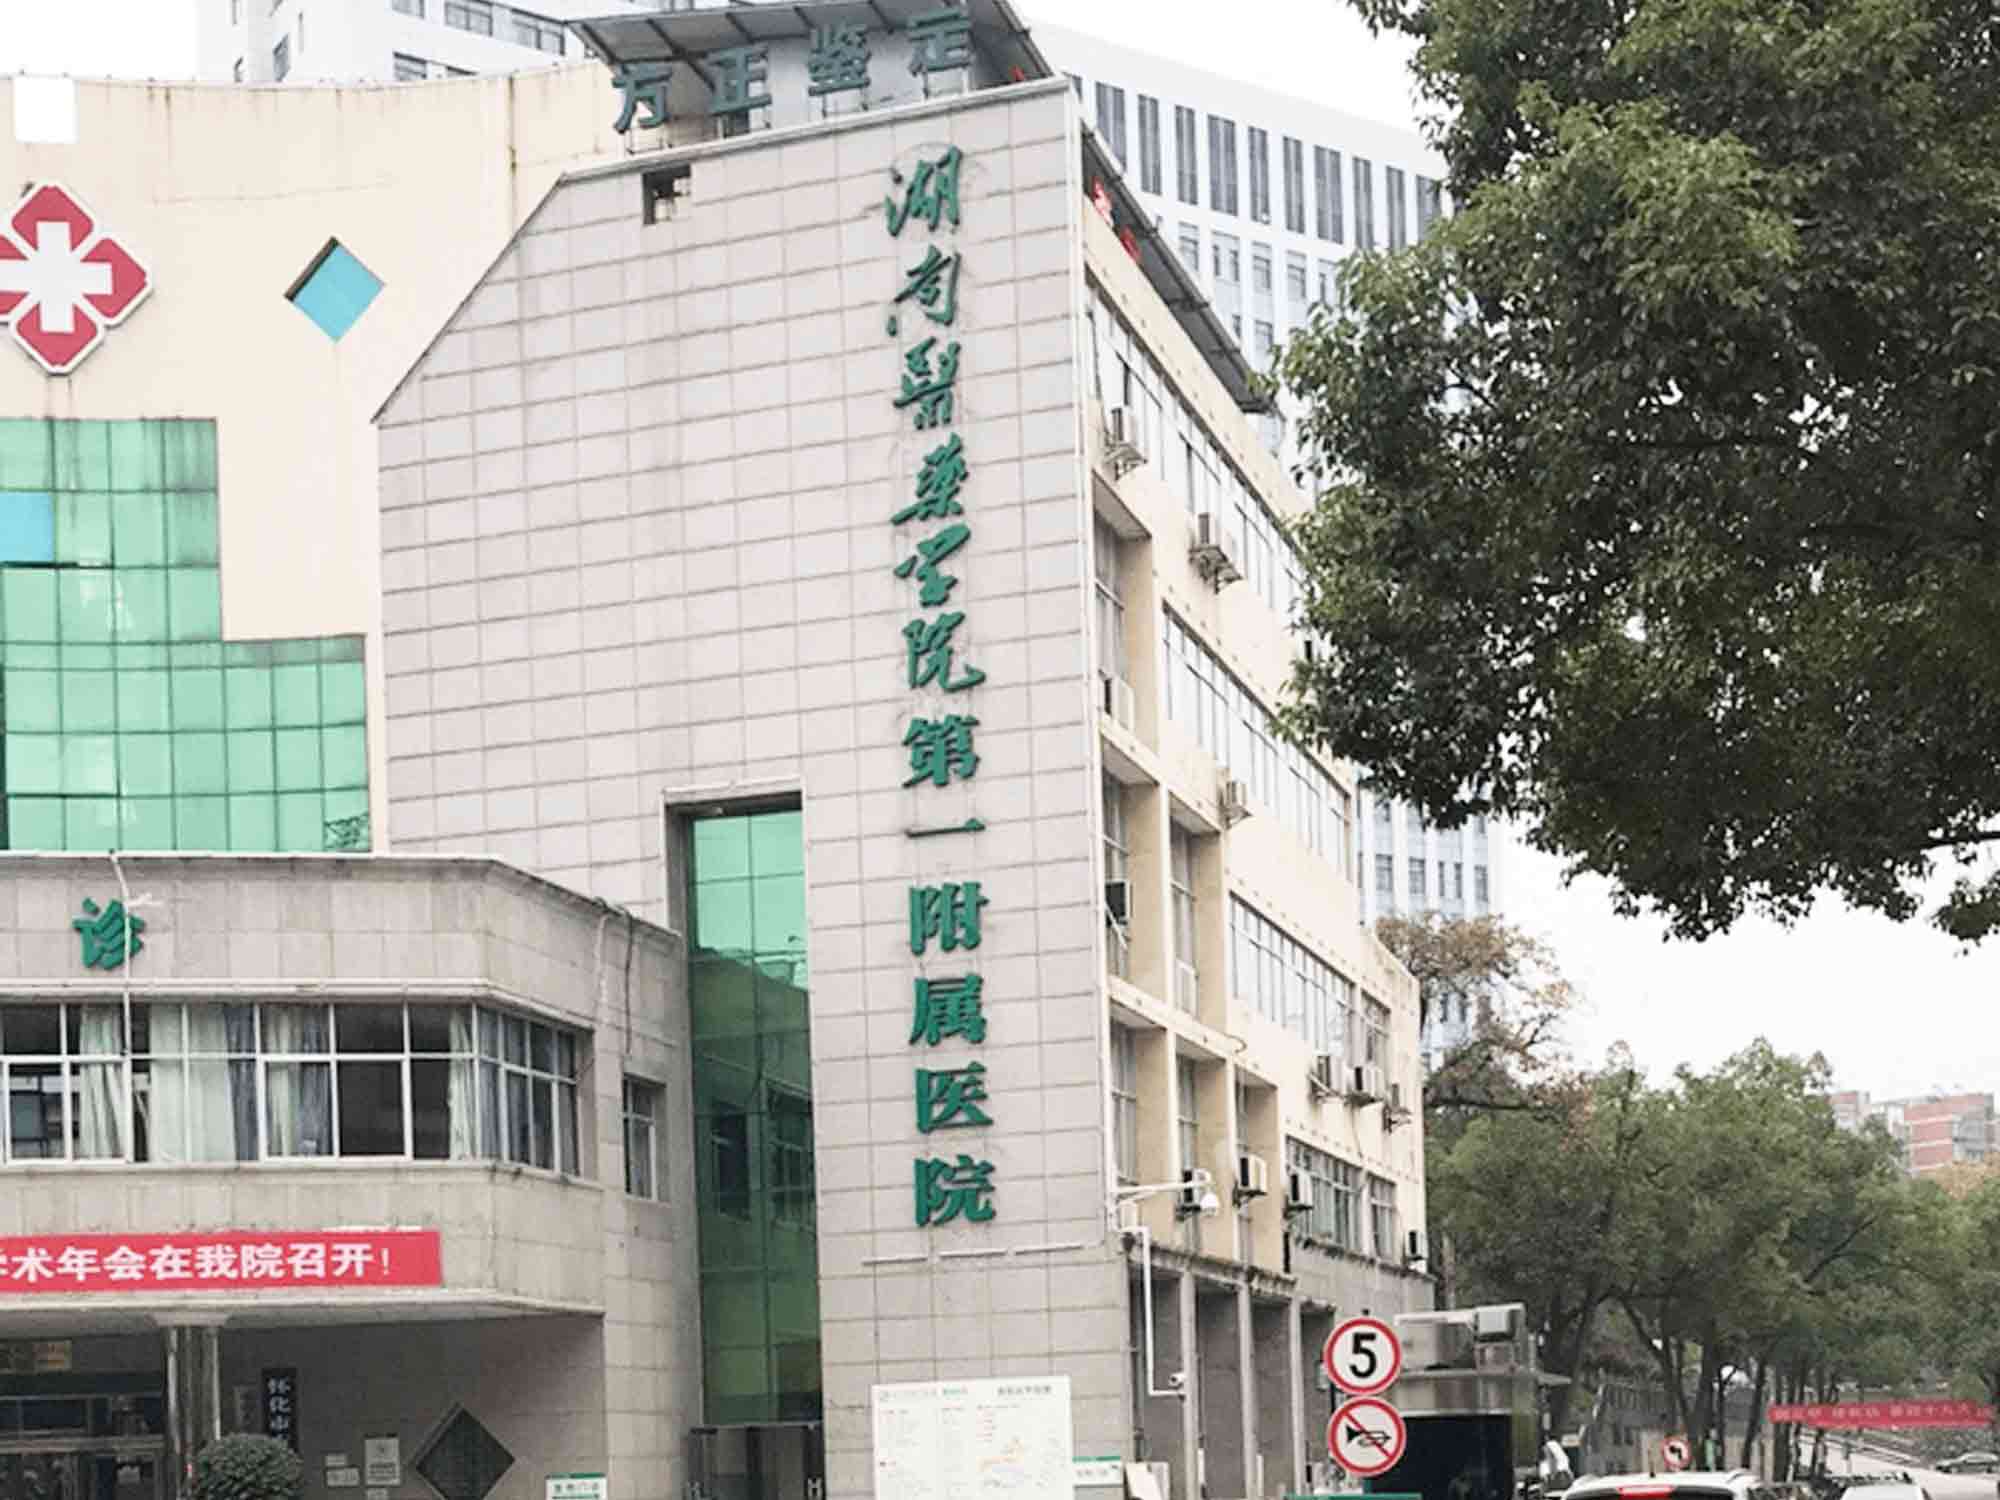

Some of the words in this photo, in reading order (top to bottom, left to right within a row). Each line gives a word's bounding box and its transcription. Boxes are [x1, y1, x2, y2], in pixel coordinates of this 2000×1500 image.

[611, 5, 974, 134] 方正鉴定
[71, 897, 146, 971] 诊
[0, 1243, 391, 1283] 术年会在我院召开！
[1349, 1332, 1377, 1378] 5
